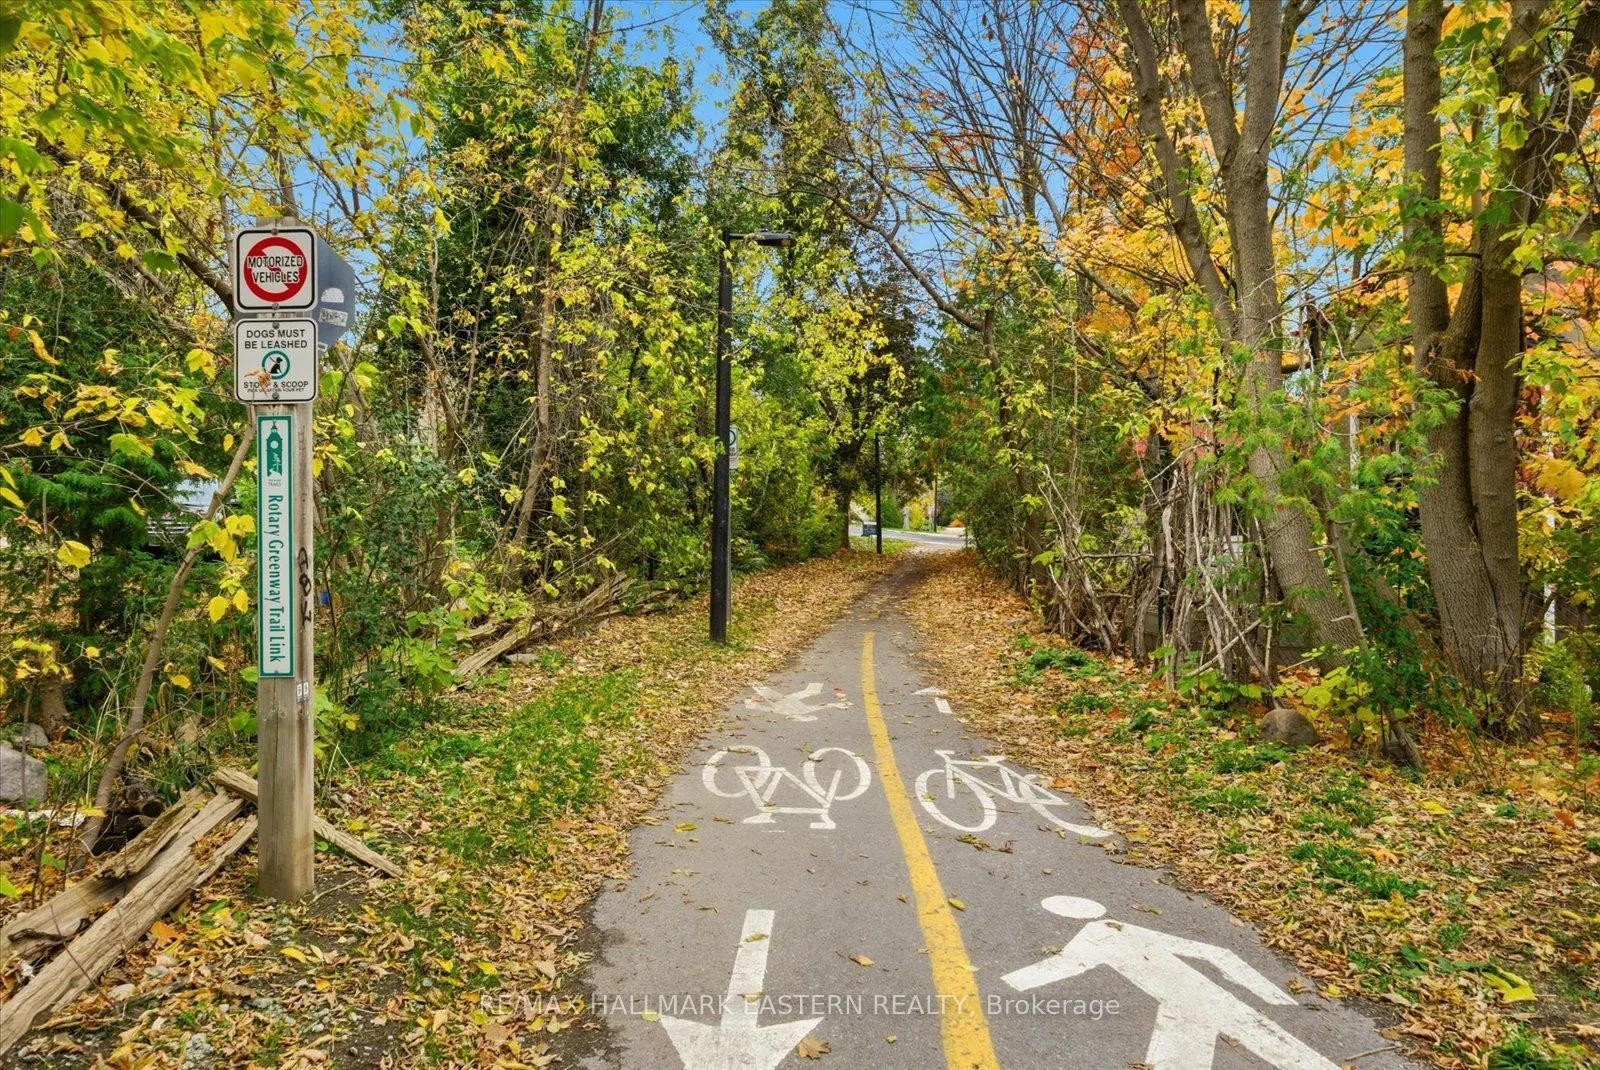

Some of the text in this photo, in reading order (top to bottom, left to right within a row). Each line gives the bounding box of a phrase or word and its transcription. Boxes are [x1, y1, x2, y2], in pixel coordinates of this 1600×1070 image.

[248, 256, 302, 267] MOTORIZED
[253, 272, 298, 282] VEHICLES
[246, 329, 305, 338] DOGS MUST
[245, 340, 308, 349] BE LEASHED
[264, 495, 283, 536] Rotary
[265, 540, 284, 603] Greenway
[269, 606, 285, 632] Trail
[269, 637, 286, 662] Link
